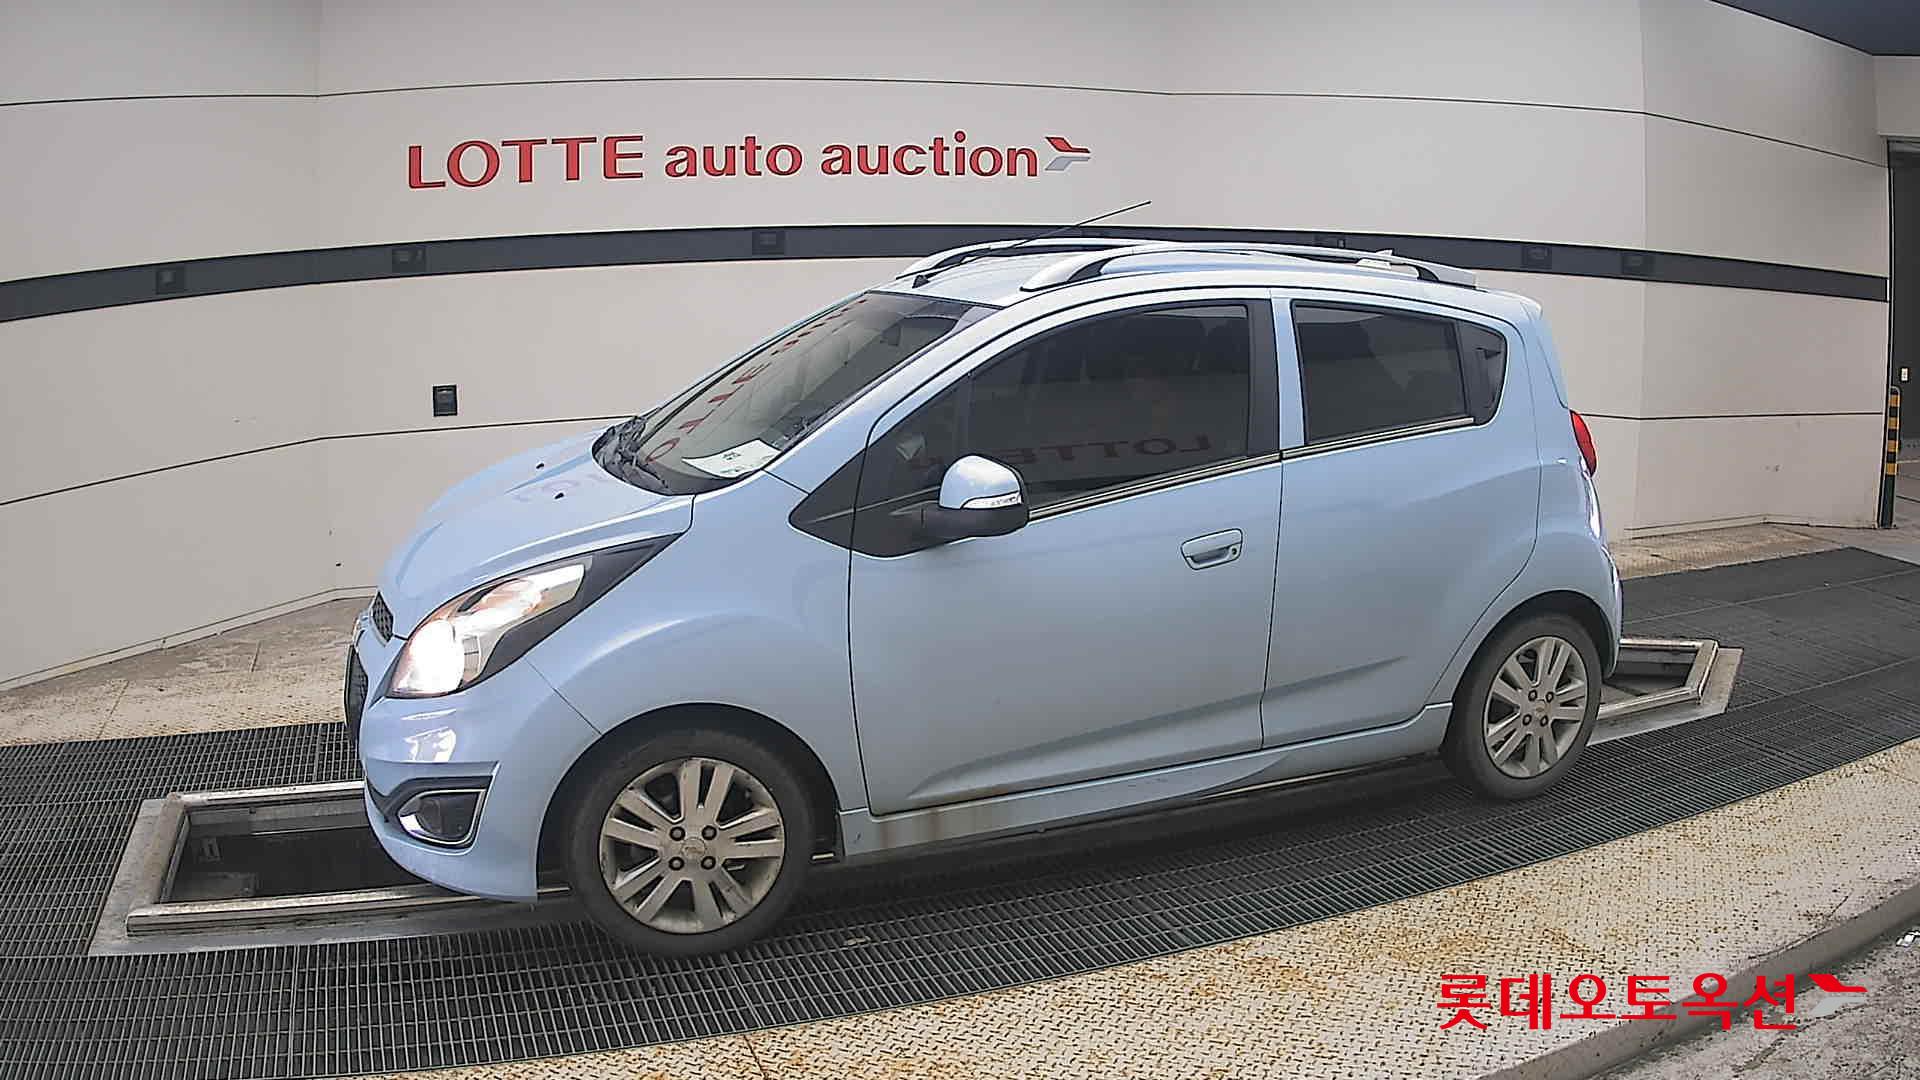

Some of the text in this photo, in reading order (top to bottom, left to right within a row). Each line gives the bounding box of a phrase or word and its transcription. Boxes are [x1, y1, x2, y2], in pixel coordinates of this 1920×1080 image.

[407, 130, 1038, 189] LOTTE auto auction
